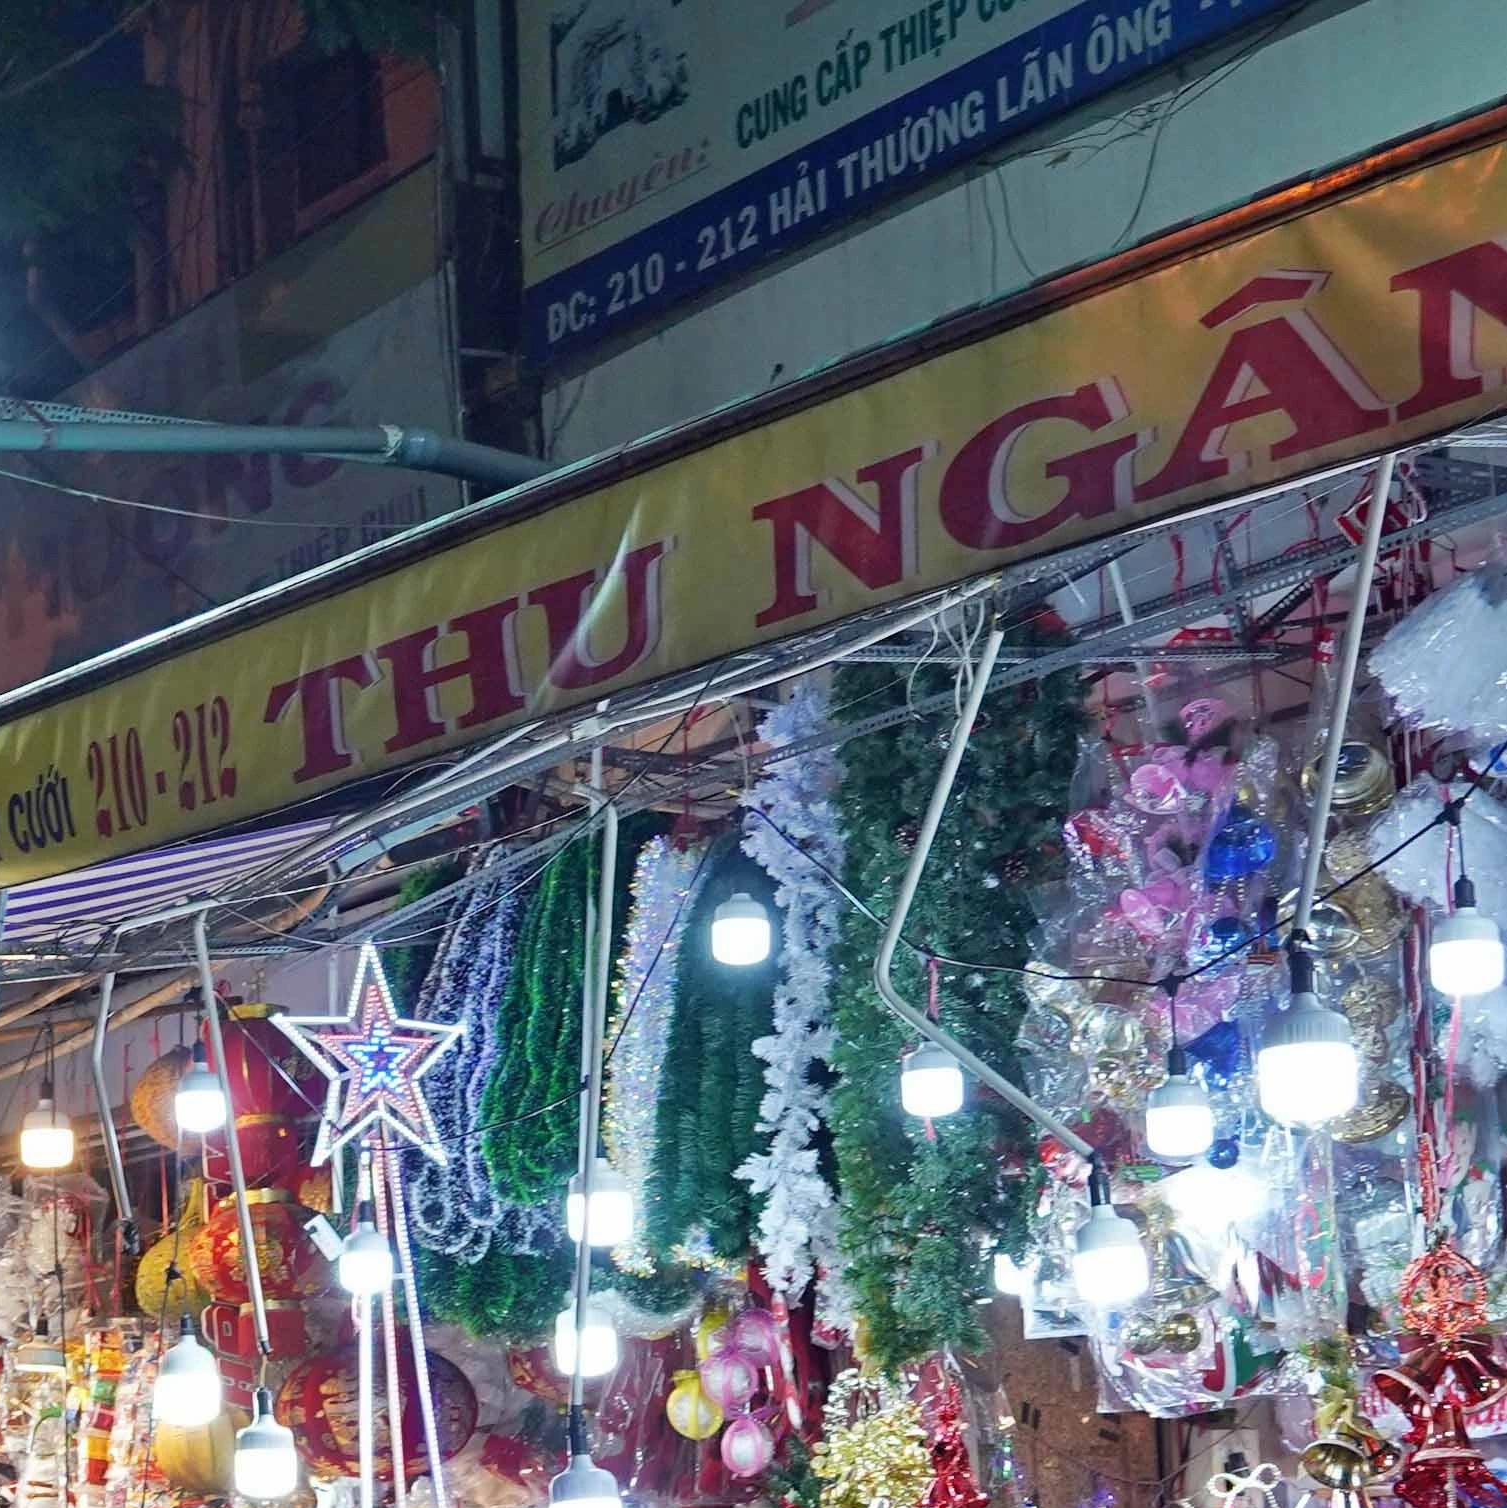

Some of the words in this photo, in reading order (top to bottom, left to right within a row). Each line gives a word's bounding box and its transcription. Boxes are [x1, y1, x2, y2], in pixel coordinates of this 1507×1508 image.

[547, 292, 597, 344] ĐC:
[606, 253, 665, 317] 210
[697, 206, 759, 272] 212
[769, 161, 827, 235] HẢI
[837, 91, 986, 200] THƯỢNG
[996, 43, 1074, 124] LÃN
[1087, 2, 1173, 75] ÔNG
[736, 76, 807, 149] CUNG
[816, 28, 871, 107] CẤP
[879, 0, 970, 74] THIỆP
[9, 765, 77, 854] CƯỚI
[88, 727, 149, 840] 210
[173, 696, 239, 811] 212
[263, 535, 678, 784] THU
